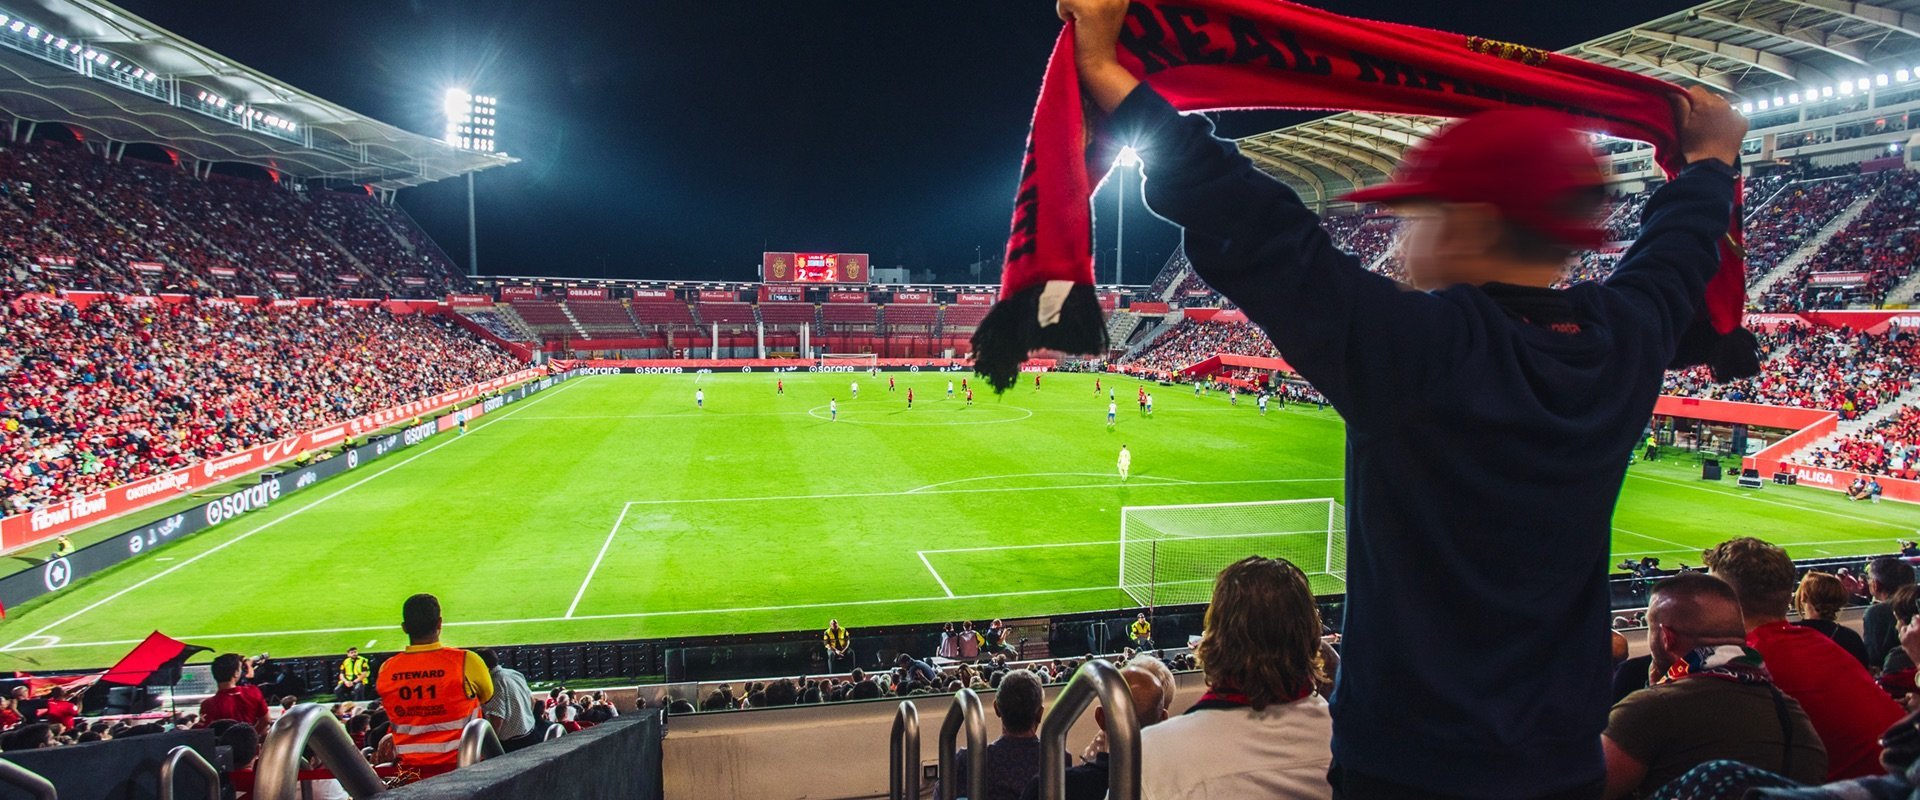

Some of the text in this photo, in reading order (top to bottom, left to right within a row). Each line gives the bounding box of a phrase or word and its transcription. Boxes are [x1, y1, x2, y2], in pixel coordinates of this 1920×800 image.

[1118, 1, 1332, 76] REAL
[798, 269, 806, 280] 2
[826, 269, 834, 280] 2
[645, 366, 682, 374] sorare
[1790, 467, 1834, 485] LALIGA
[222, 479, 280, 518] sorare
[30, 492, 107, 532] fibwi fibwi
[391, 669, 445, 681] STEWARD
[399, 685, 436, 700] 011
